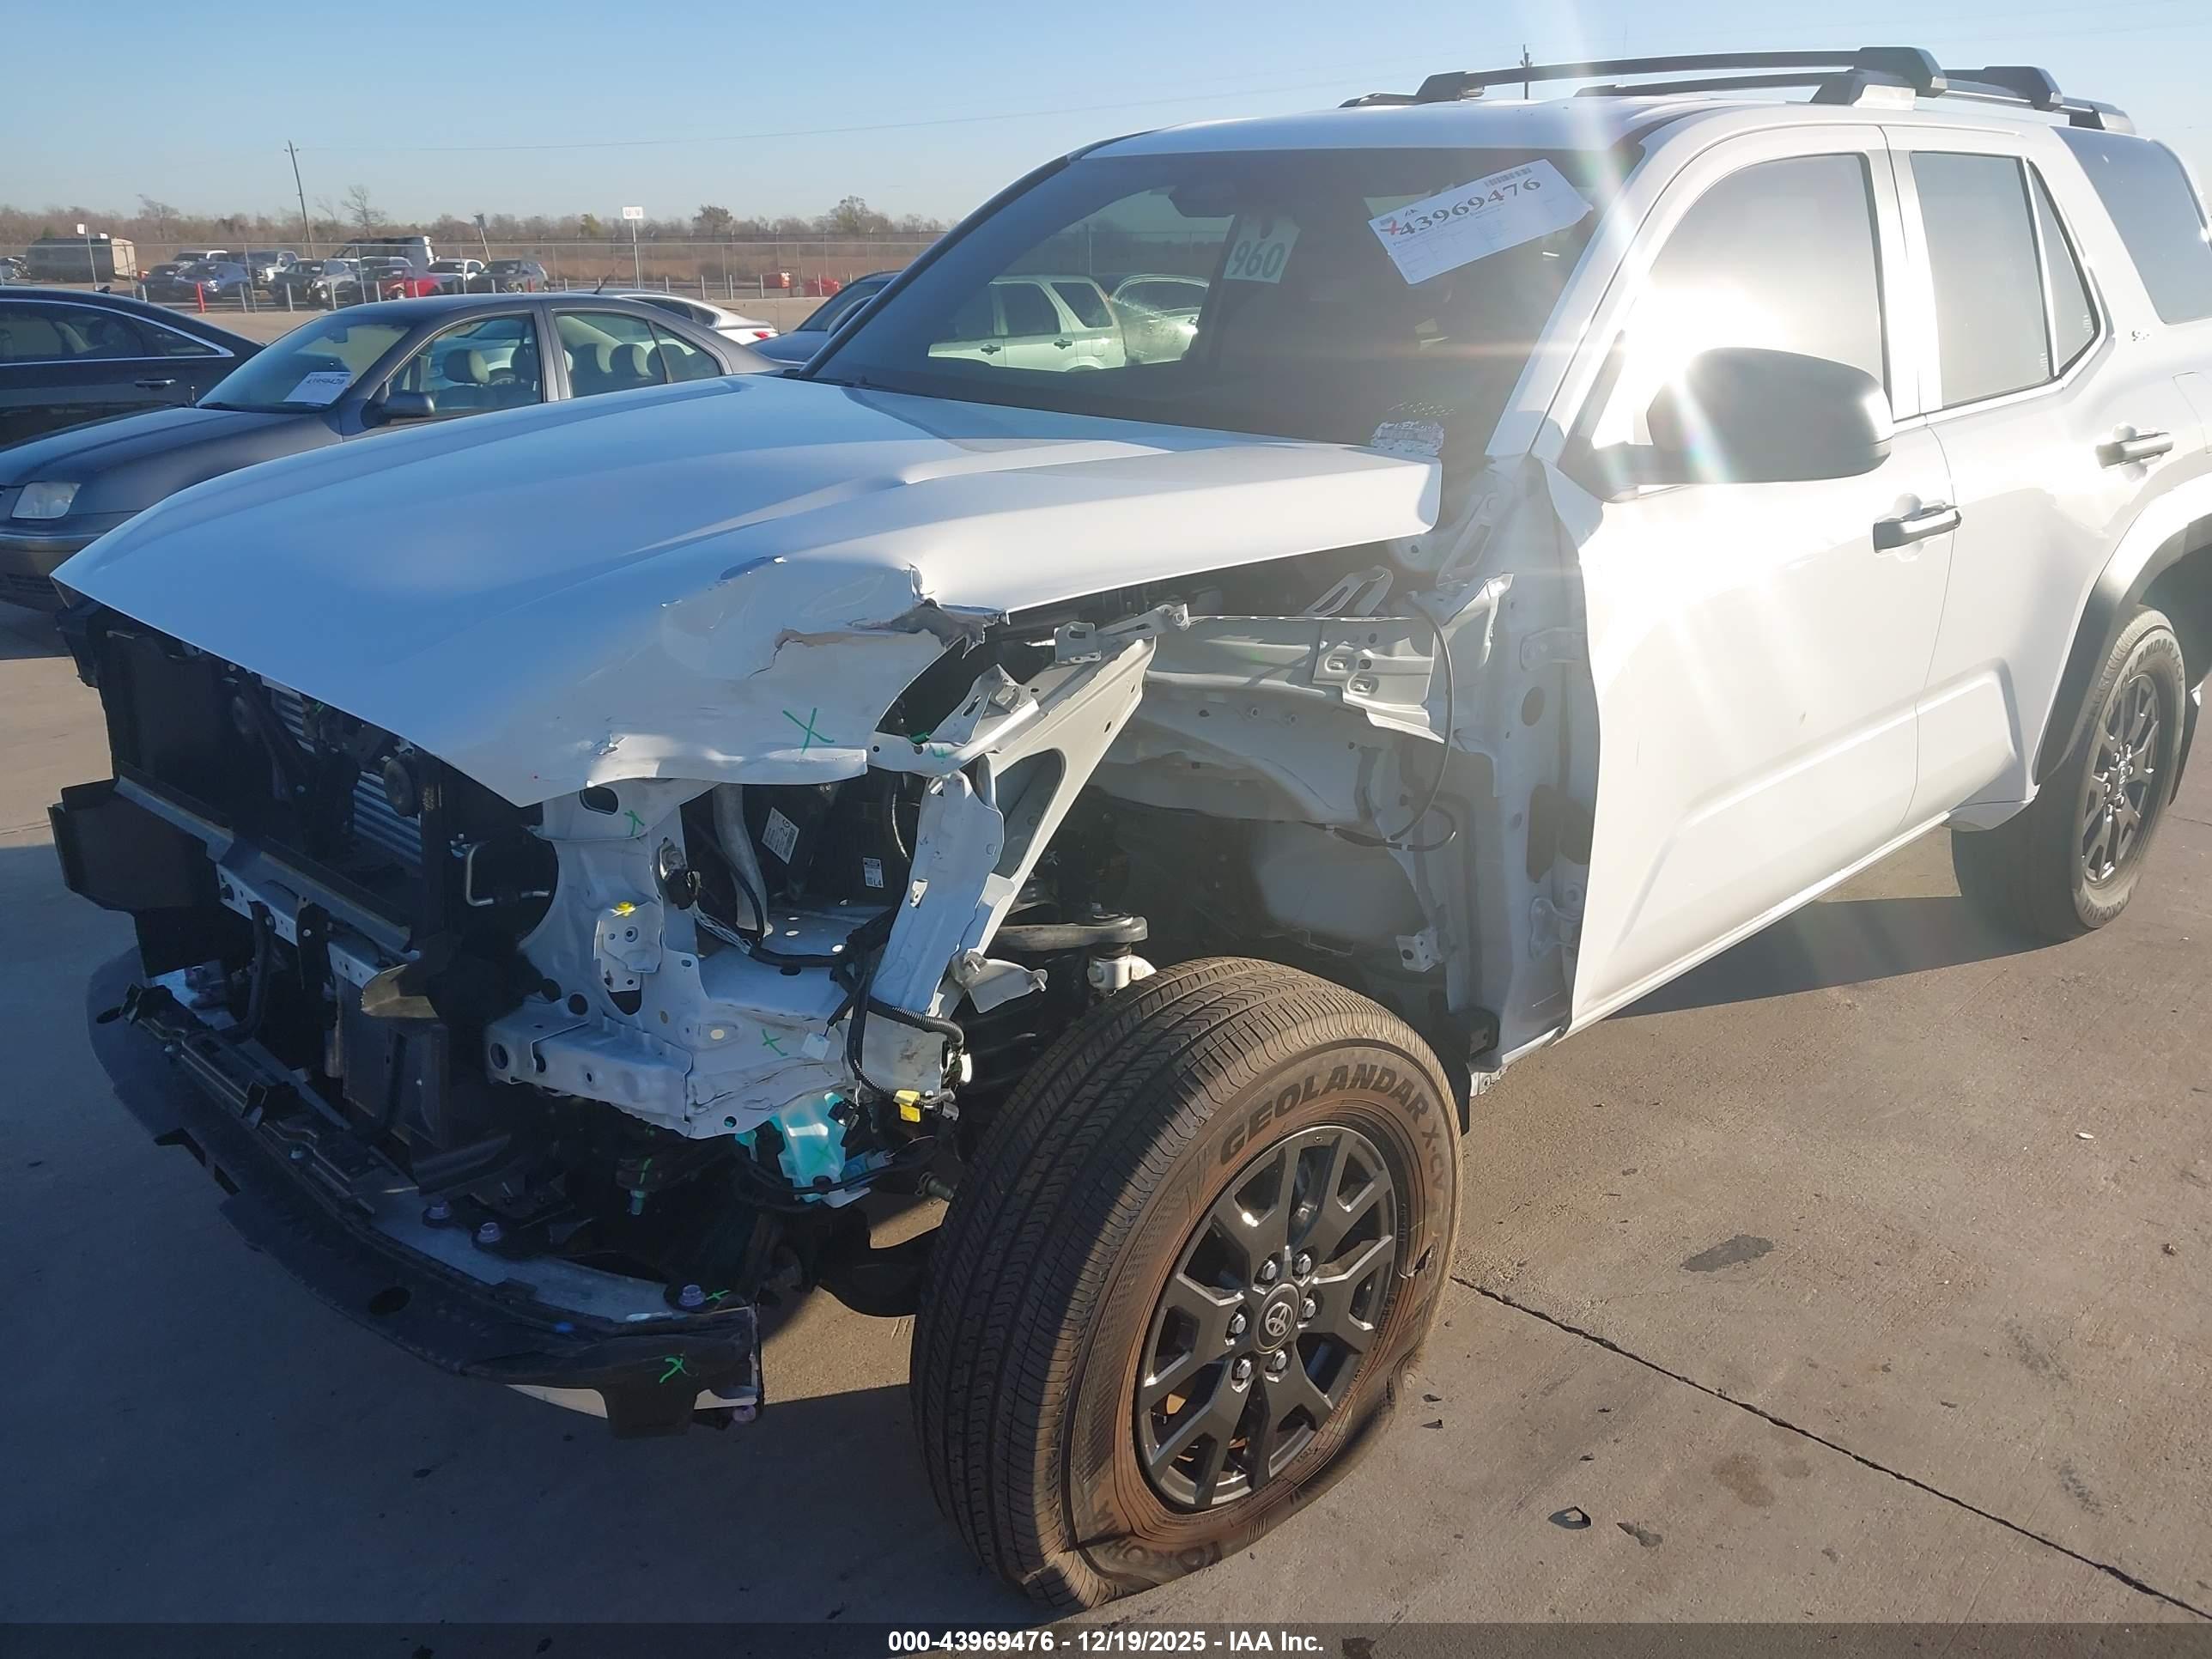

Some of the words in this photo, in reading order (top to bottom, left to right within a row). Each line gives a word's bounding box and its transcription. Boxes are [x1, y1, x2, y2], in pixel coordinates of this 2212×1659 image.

[1399, 177, 1541, 236] 43969476
[1231, 240, 1286, 278] 960
[1219, 1063, 1430, 1166] GEOLANDAR
